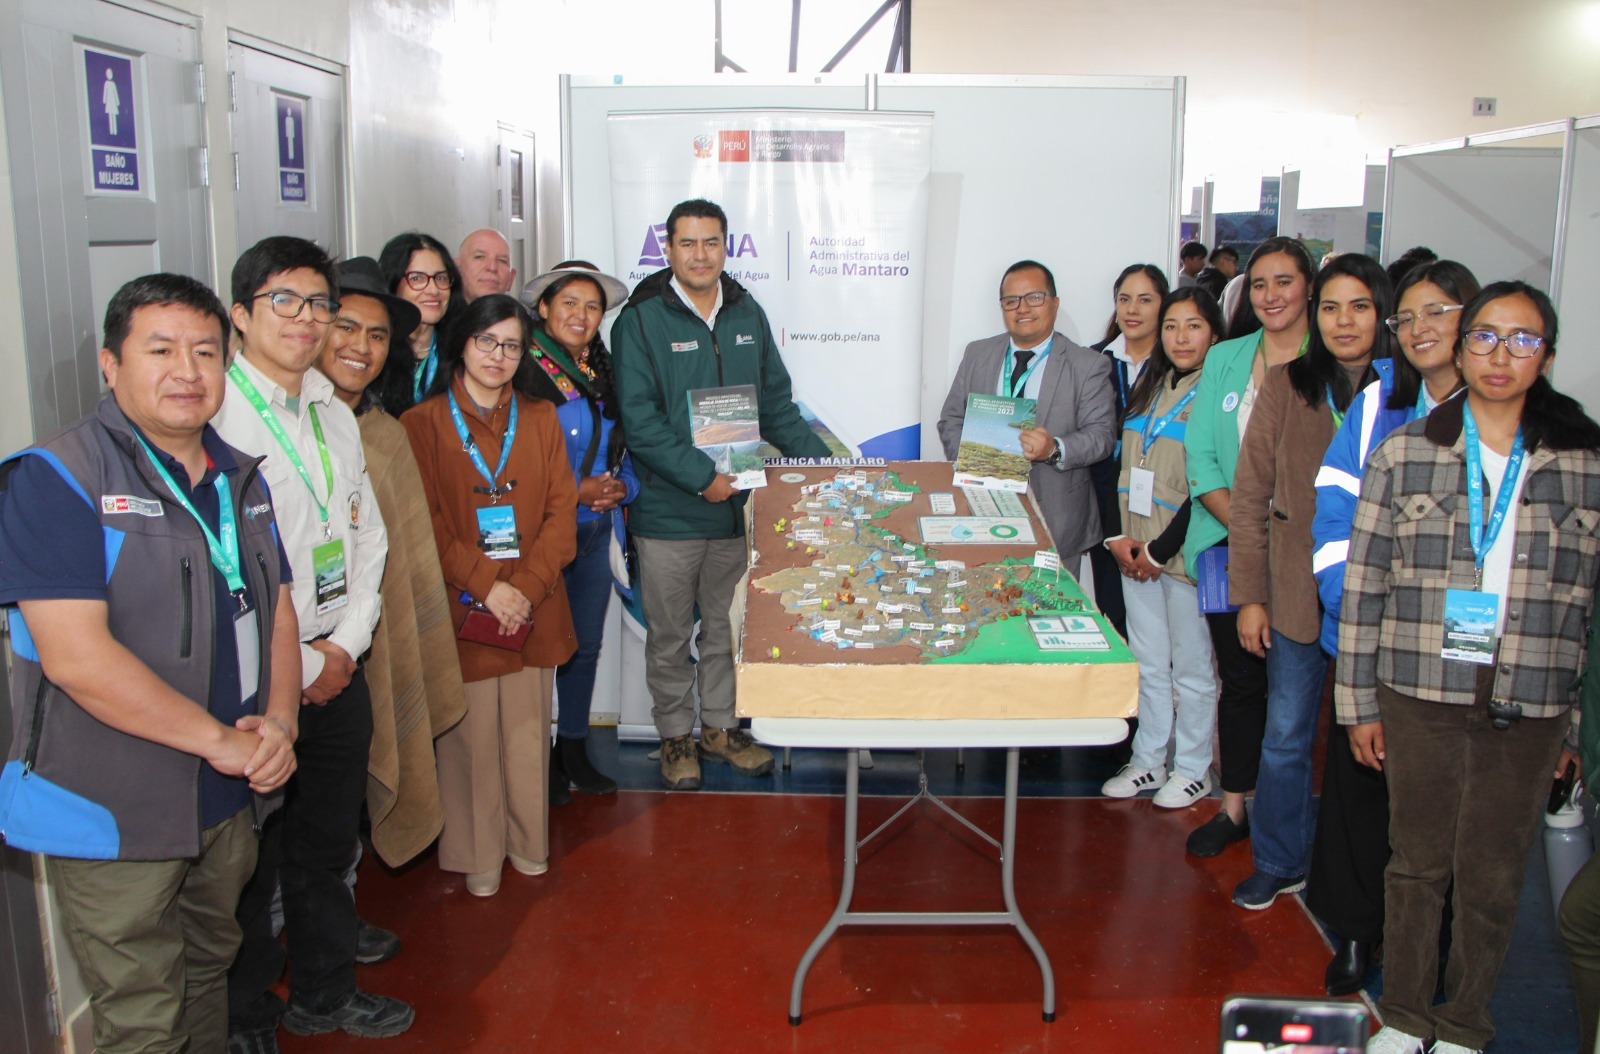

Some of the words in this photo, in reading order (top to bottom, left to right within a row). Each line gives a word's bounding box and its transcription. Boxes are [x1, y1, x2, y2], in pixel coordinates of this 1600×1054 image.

[723, 140, 746, 151] PERÚ
[803, 143, 830, 153] Agrario
[105, 152, 126, 168] BAÑO
[99, 170, 134, 186] MUJERES
[810, 236, 865, 246] Autoridad
[810, 250, 890, 261] Administrativa
[893, 250, 910, 261] del
[810, 264, 838, 276] Agua
[842, 263, 909, 276] Mantaro
[745, 271, 770, 282] Agua
[790, 331, 880, 343] www.gob.pe/ana
[997, 407, 1015, 416] 2023
[763, 457, 816, 466] CUENCA
[820, 457, 885, 466] MANTARO
